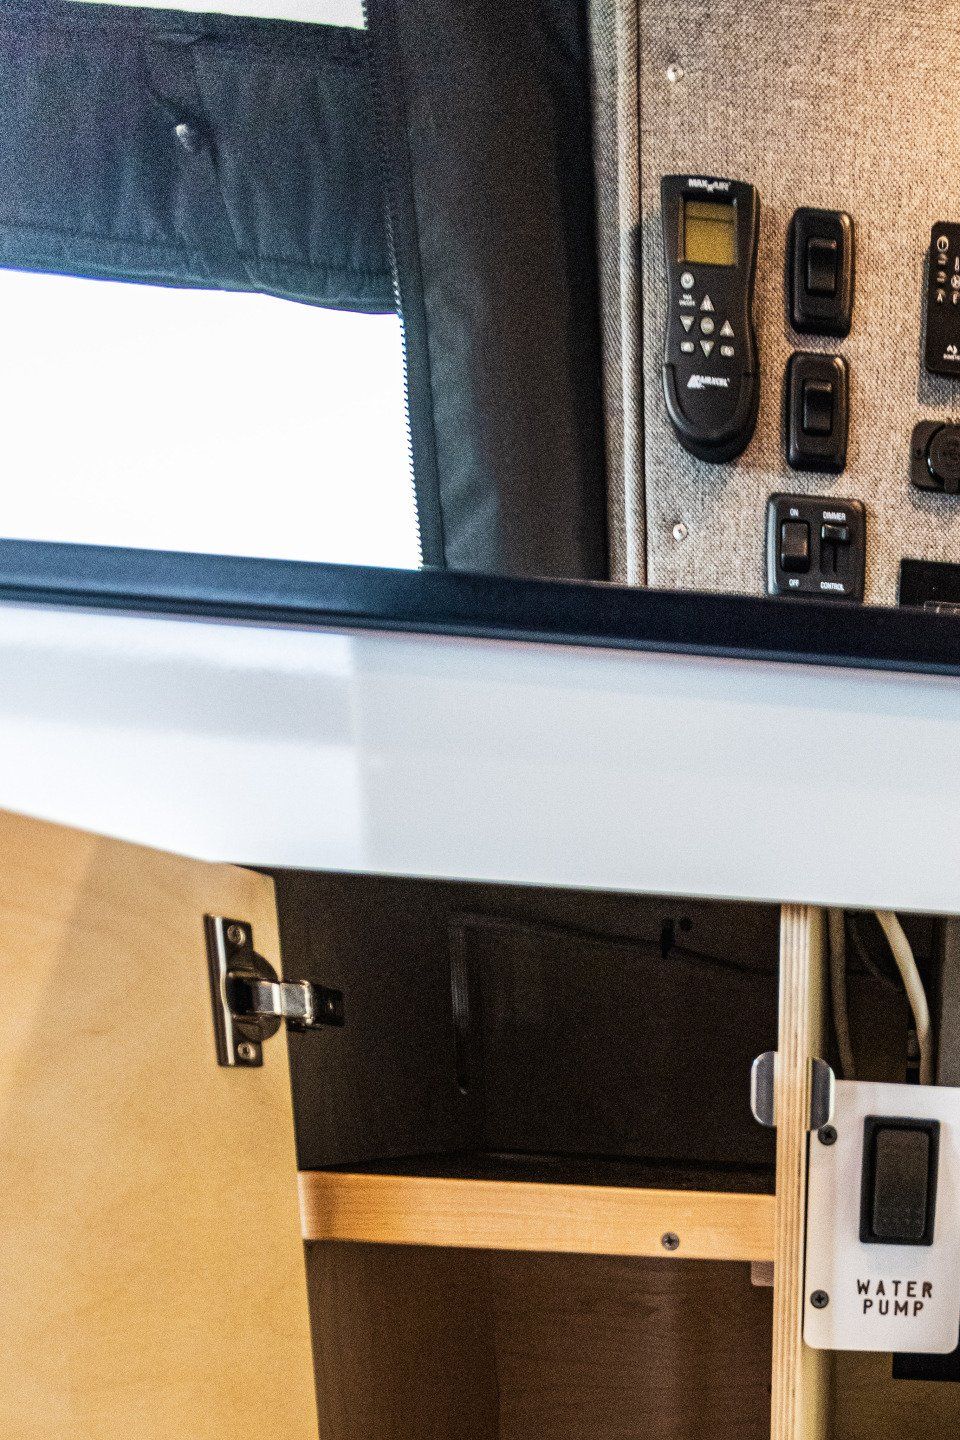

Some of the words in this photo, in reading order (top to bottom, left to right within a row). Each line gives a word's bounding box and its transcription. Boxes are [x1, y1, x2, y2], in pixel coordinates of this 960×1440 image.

[789, 508, 799, 517] ON
[822, 511, 846, 520] DIMMER
[788, 579, 800, 588] OFF
[820, 581, 844, 591] CONTROL
[857, 1279, 933, 1298] WATER
[863, 1298, 924, 1317] PUMP
